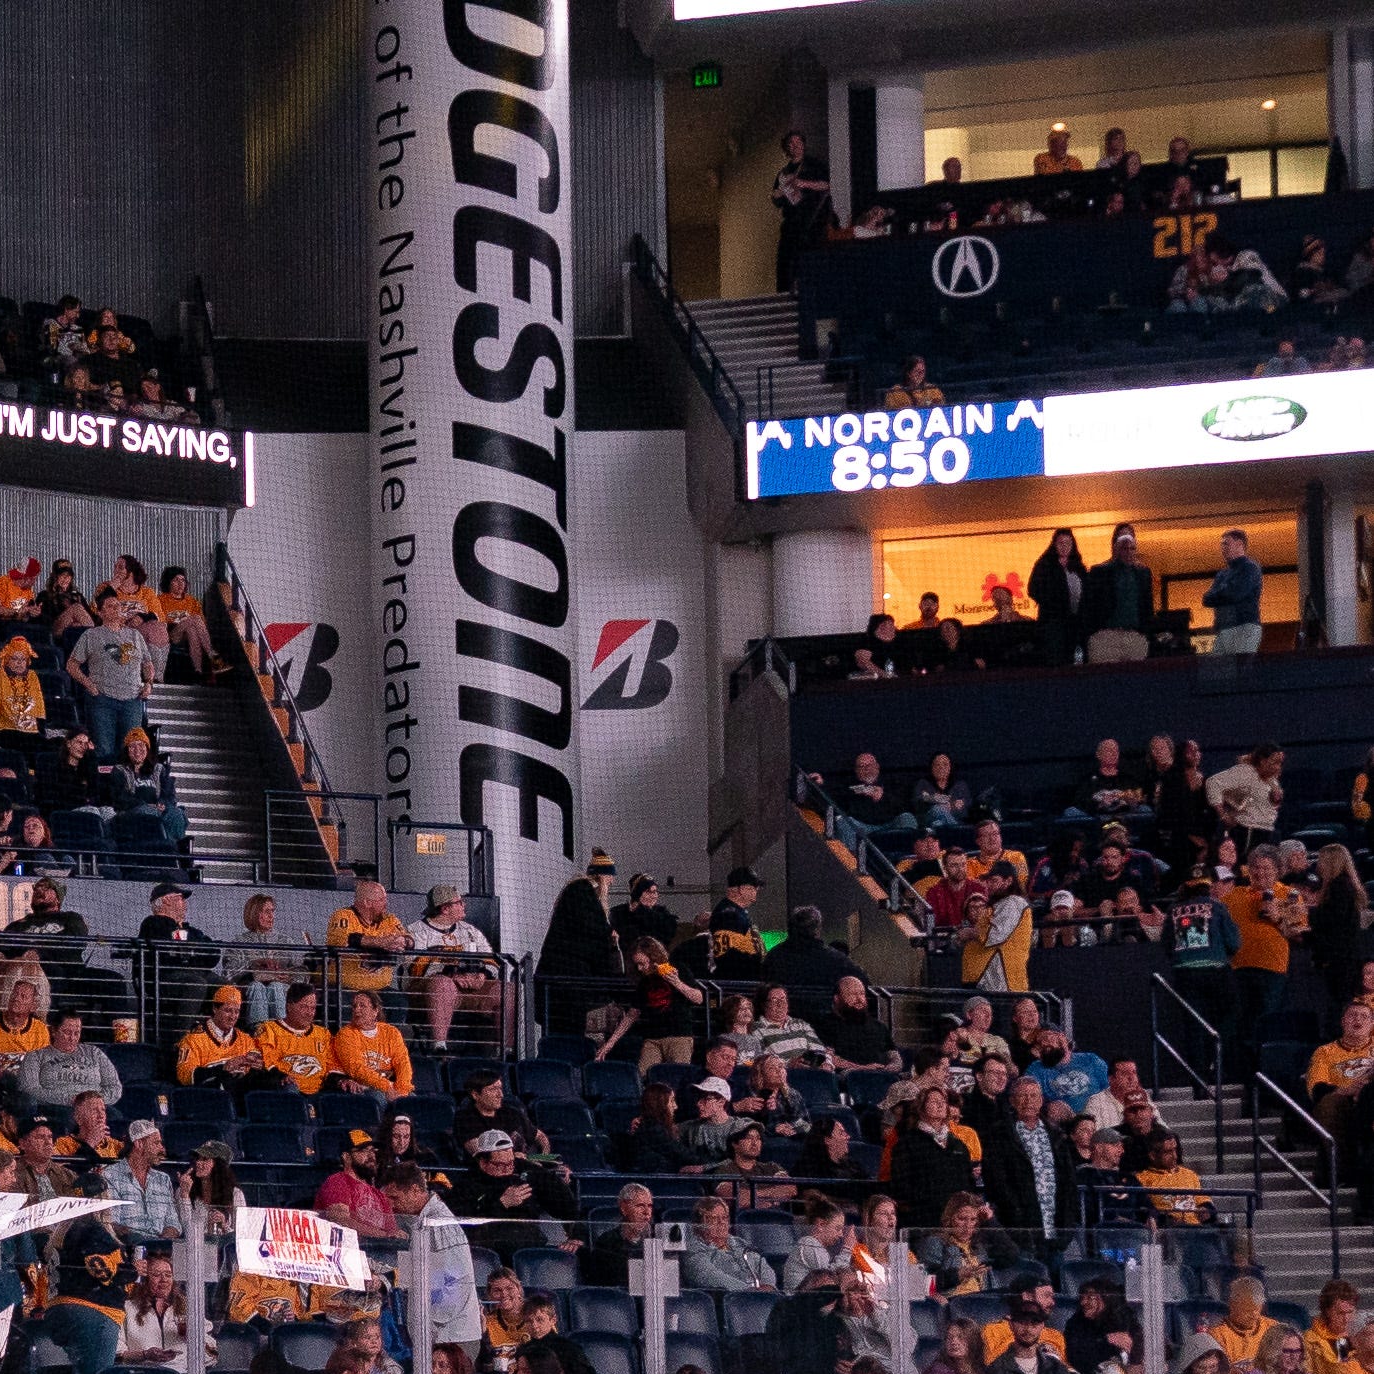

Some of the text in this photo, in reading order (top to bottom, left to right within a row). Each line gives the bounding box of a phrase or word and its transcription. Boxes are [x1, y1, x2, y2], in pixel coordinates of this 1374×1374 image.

[375, 25, 413, 83] of
[376, 101, 416, 211] the
[376, 228, 418, 513] Nashville
[41, 410, 117, 448] JUST
[121, 420, 237, 468] SAYING,
[804, 403, 993, 448] NORQAIN
[832, 436, 970, 492] 8:50
